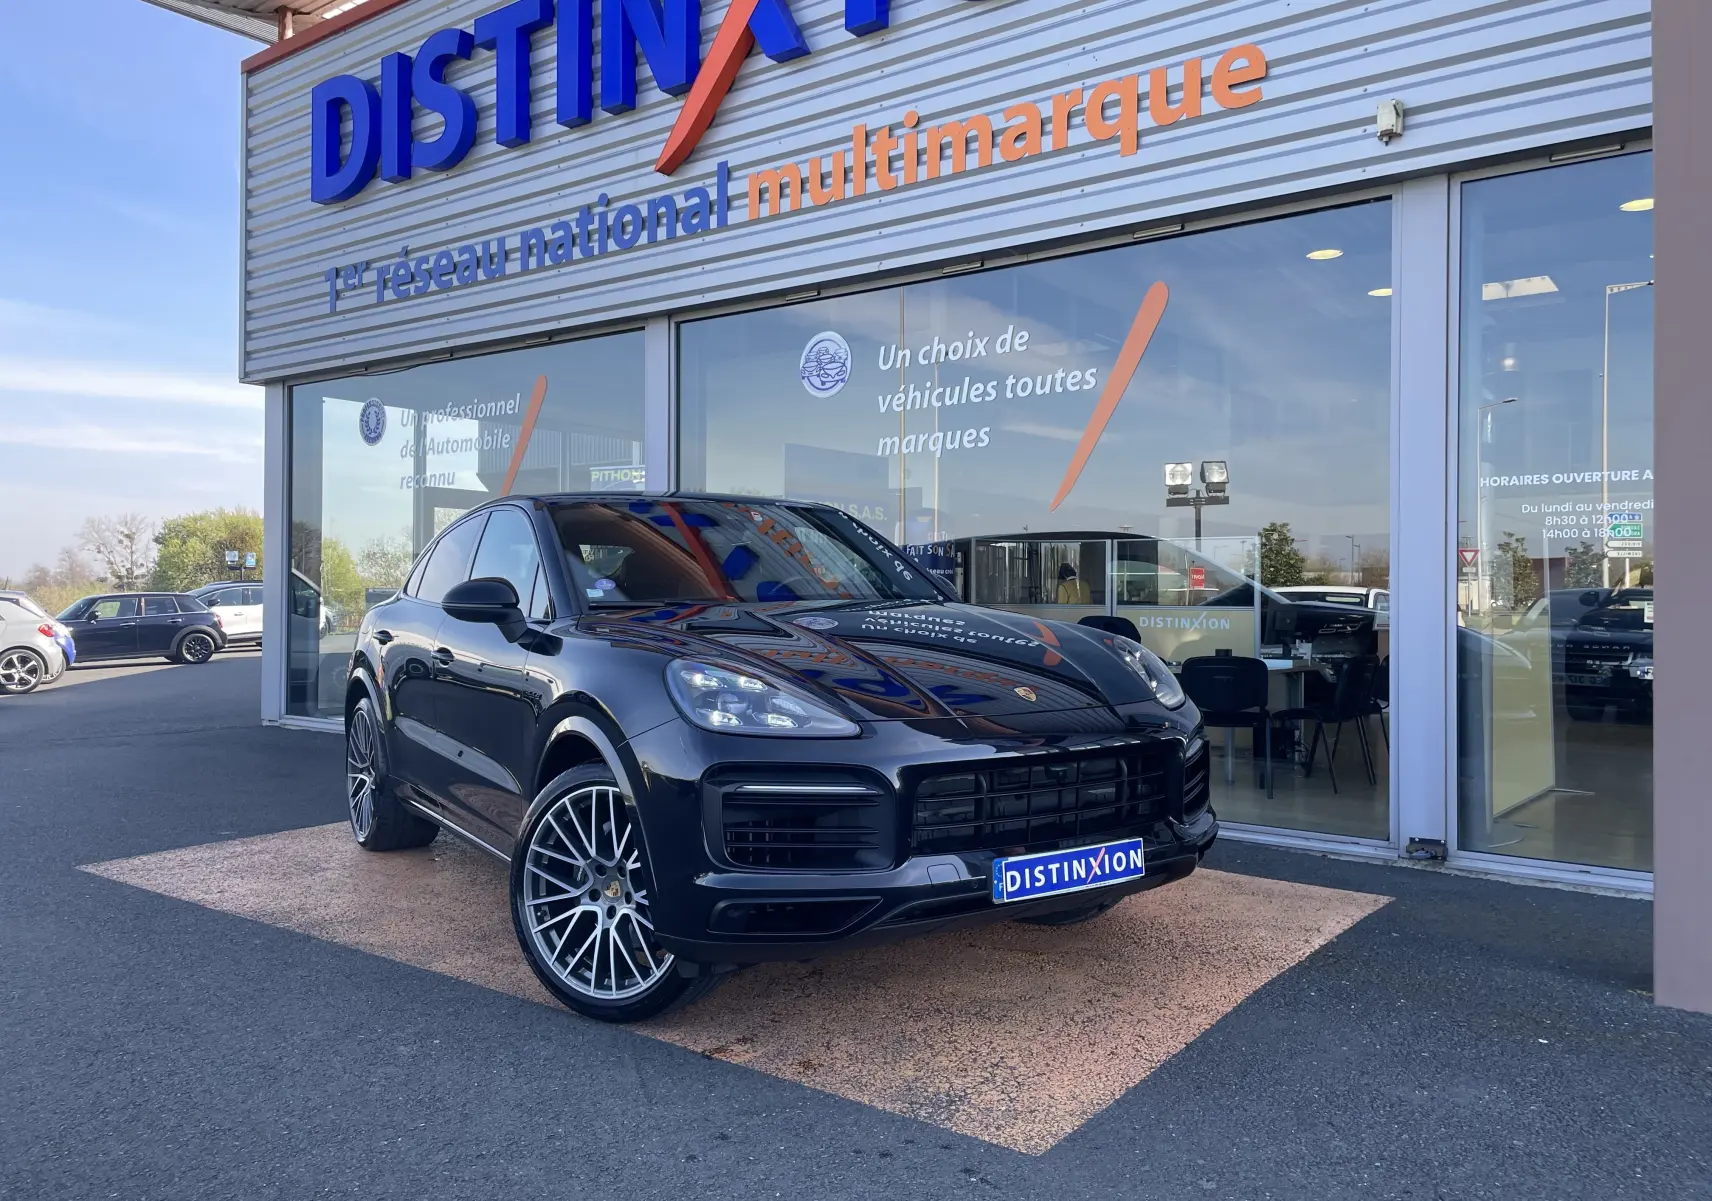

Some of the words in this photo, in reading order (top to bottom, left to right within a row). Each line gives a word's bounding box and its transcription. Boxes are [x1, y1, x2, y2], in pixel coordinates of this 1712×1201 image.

[324, 260, 369, 314] 1er
[376, 245, 507, 304] réseau
[520, 160, 728, 273] national
[747, 43, 1268, 220] multimarque
[877, 344, 911, 371] Un
[918, 330, 990, 365] choix
[995, 324, 1030, 354] de
[877, 376, 998, 413] véhicules
[1004, 367, 1098, 399] toutes
[400, 409, 418, 428] Un
[420, 392, 520, 431] professionnel
[400, 439, 416, 459] de
[876, 426, 991, 458] marques
[400, 471, 455, 490] reconnu
[1480, 474, 1549, 488] HORAIRES
[1552, 469, 1640, 485] OUVERTURE
[1521, 503, 1538, 514] Du
[1541, 501, 1573, 513] lundi
[1575, 503, 1593, 512] au
[1595, 499, 1654, 511] vendredi
[1545, 515, 1576, 526] 8h30
[1579, 514, 1589, 525] à
[1591, 513, 1629, 525] 12h00
[1541, 528, 1579, 539] 14h00
[1581, 527, 1591, 538] à
[1593, 527, 1632, 538] 18h00
[1139, 611, 1231, 633] DISTINXION
[1006, 847, 1143, 893] DISTINXION
